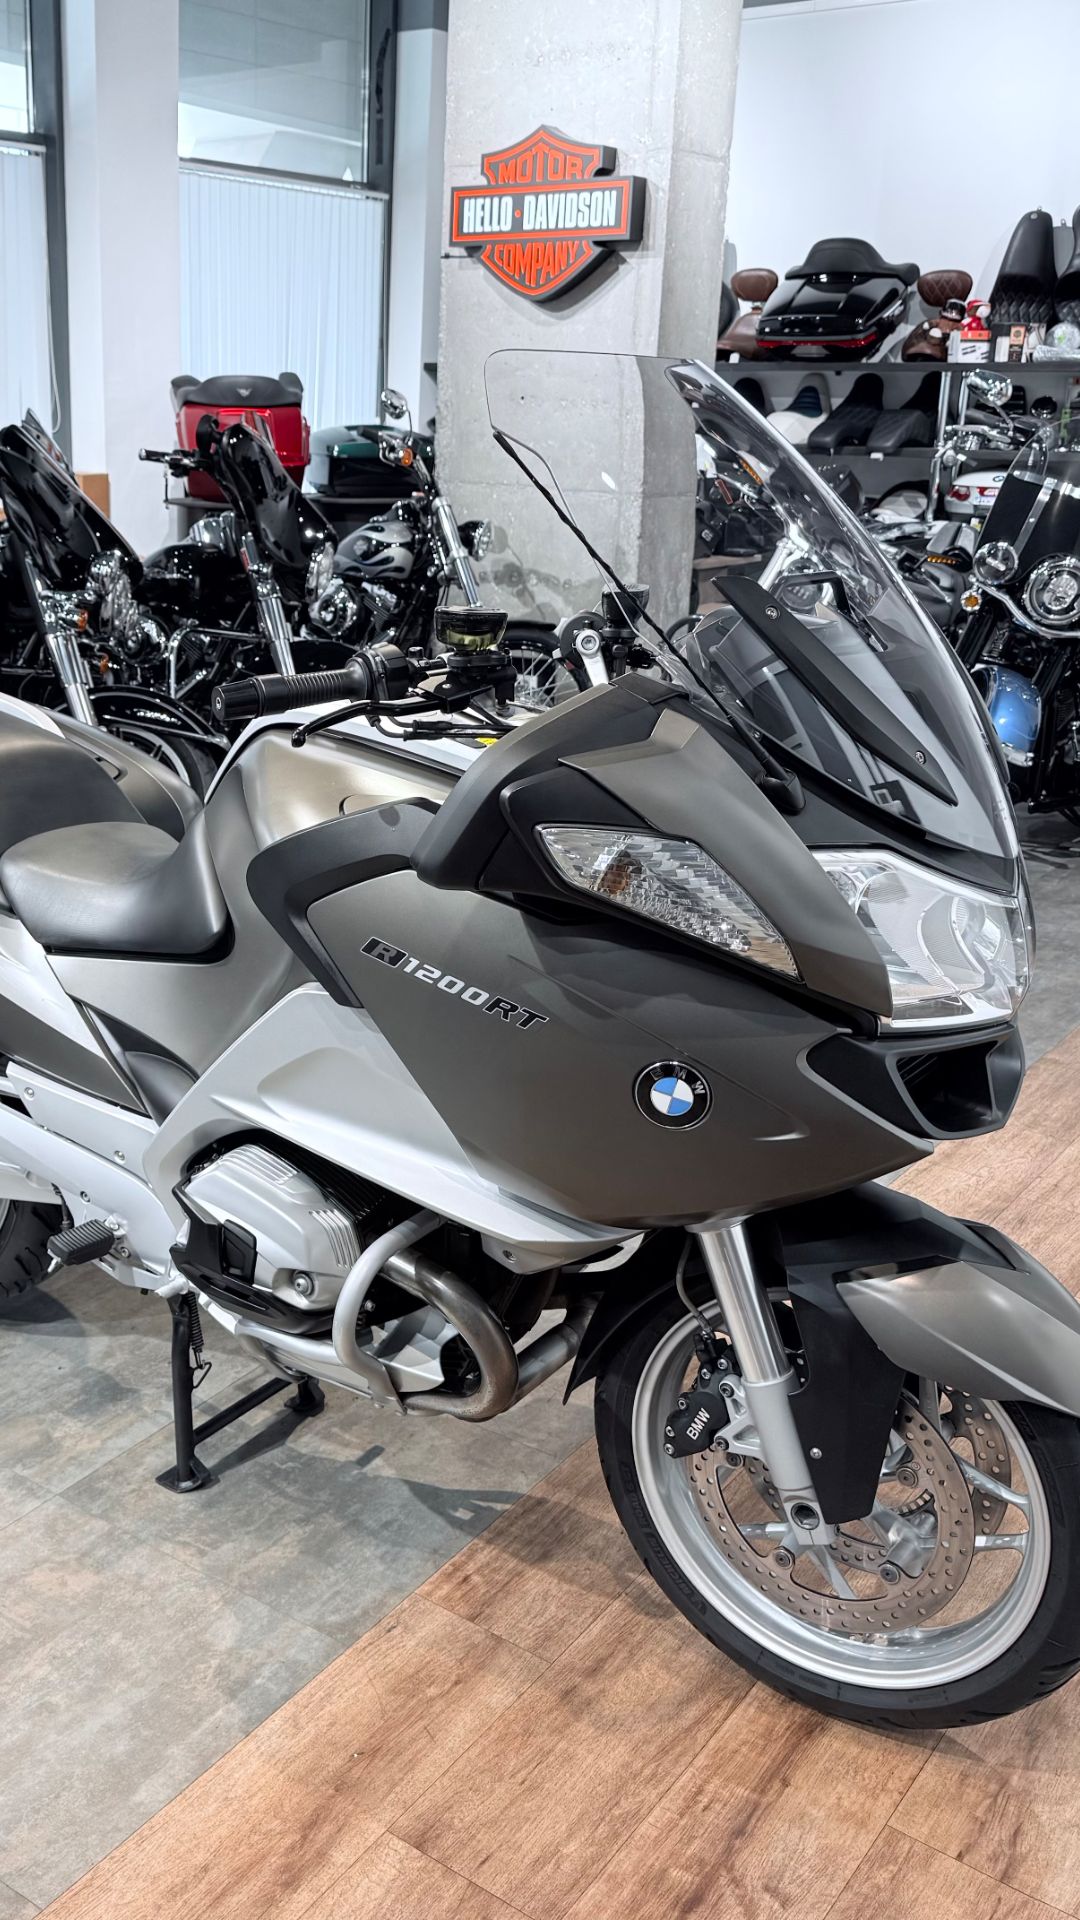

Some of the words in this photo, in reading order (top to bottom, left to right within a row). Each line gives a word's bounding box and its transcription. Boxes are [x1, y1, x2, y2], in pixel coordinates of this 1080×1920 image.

[498, 142, 584, 185] MOTOR
[462, 195, 513, 234] HELLO
[522, 190, 617, 231] DAVIDSON
[493, 240, 580, 288] COMPANY
[650, 1065, 706, 1096] BMW
[686, 1407, 712, 1441] BMW
